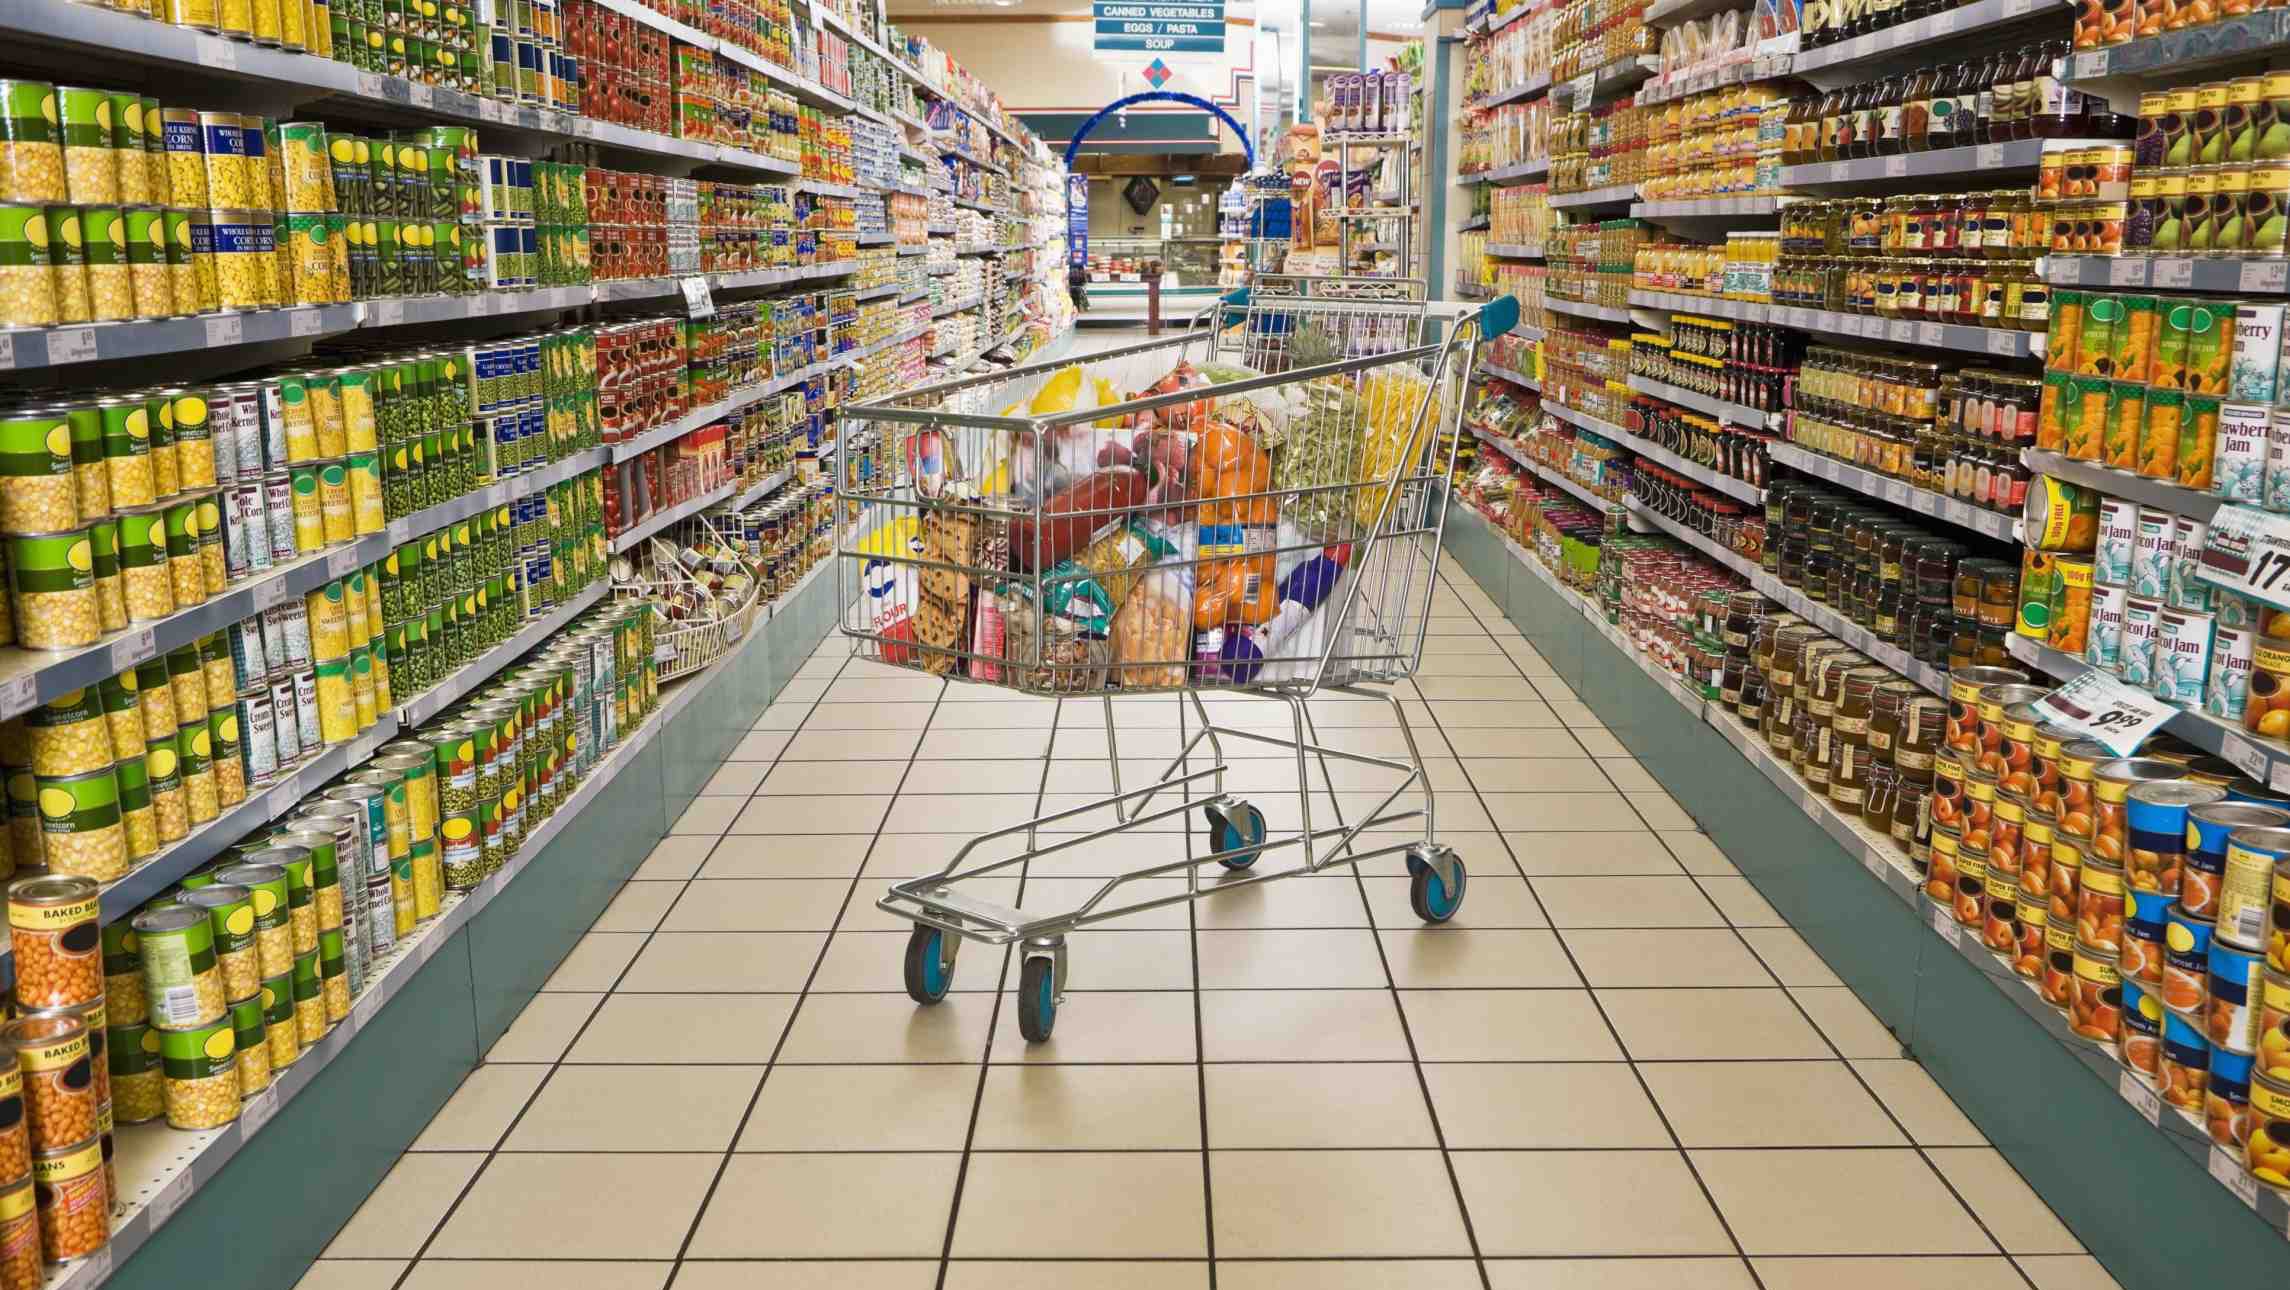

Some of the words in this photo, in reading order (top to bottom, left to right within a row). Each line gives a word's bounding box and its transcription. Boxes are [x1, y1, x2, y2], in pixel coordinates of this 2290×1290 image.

[1103, 6, 1147, 17] CANNED
[1150, 7, 1215, 18] VEGETABLES
[1123, 23, 1153, 33] EGGS
[1166, 24, 1198, 34] PASTA
[1145, 39, 1175, 49] SOUP
[2224, 437, 2251, 452] Jam
[2107, 525, 2132, 540] Jam
[2174, 638, 2200, 655] Jam
[43, 905, 82, 919] BAKED
[44, 1041, 81, 1059] BAKED
